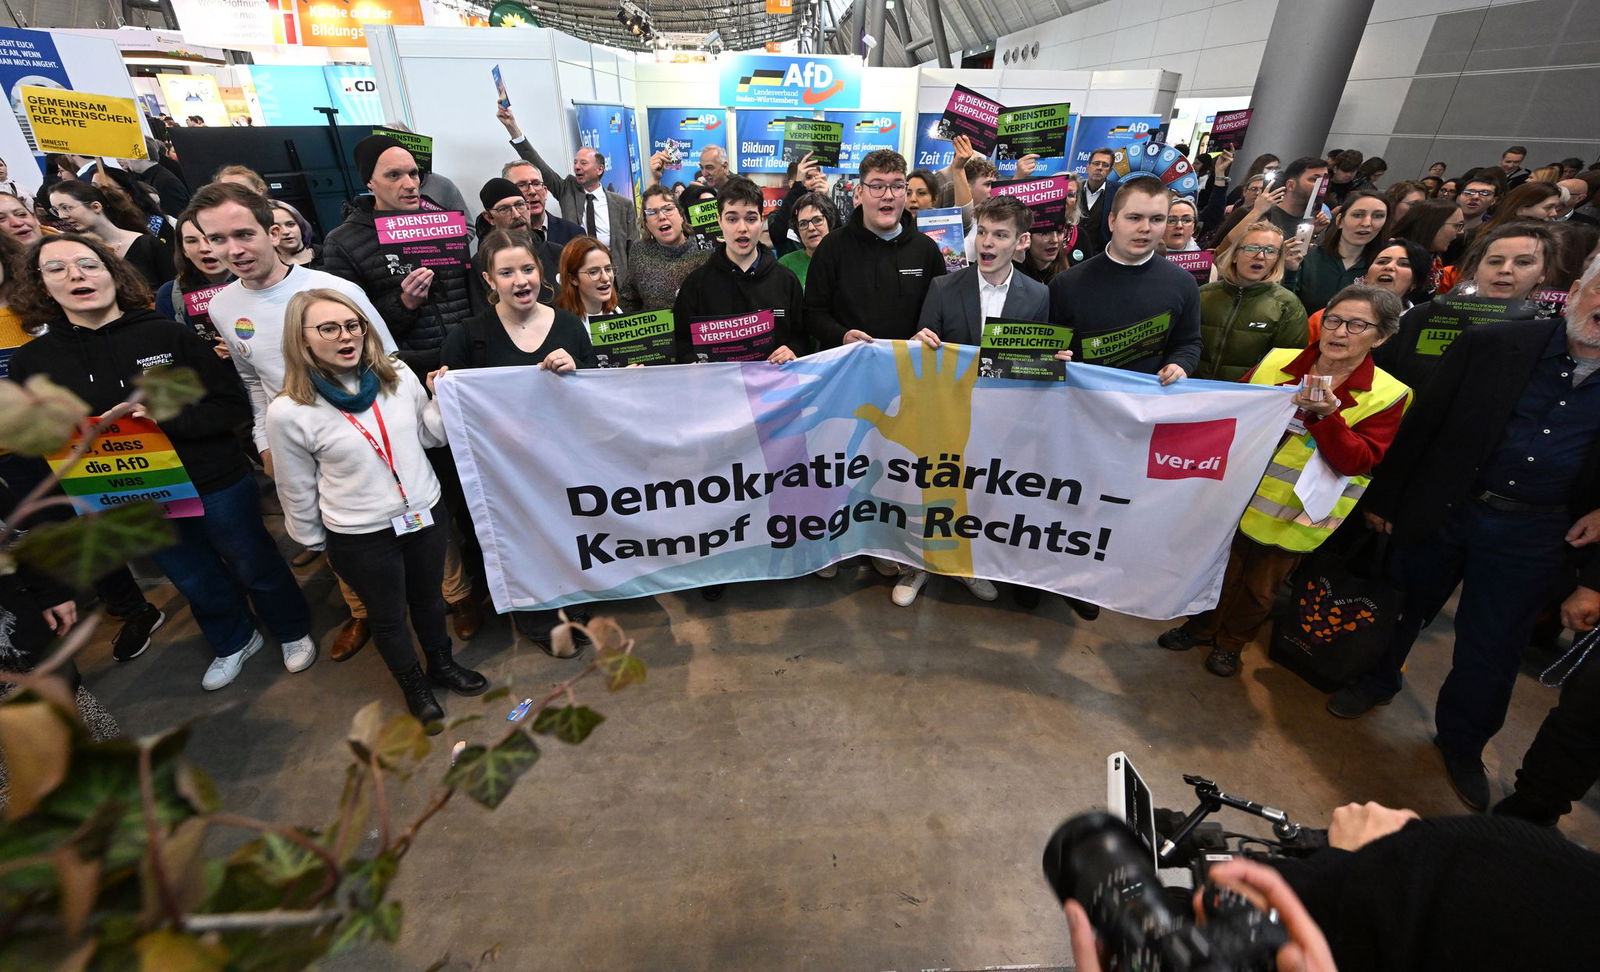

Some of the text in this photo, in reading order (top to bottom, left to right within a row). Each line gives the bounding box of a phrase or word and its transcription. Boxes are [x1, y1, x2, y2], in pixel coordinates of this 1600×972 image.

[18, 40, 34, 49] EUCH
[32, 60, 59, 68] ANGEHT.
[783, 62, 833, 88] AfD
[354, 80, 376, 92] CD
[27, 95, 107, 112] GEMEINSAM
[30, 105, 137, 124] MENSCHEN- FÜR
[698, 114, 717, 125] AfD
[954, 102, 998, 125] VERPFLICHTE
[1004, 108, 1056, 124] #DIENSTEID
[33, 115, 87, 128] RECHTE
[792, 123, 832, 132] #DIENSTEID
[873, 117, 892, 127] AfD
[1004, 117, 1065, 133] VERPFLICHTET!
[1128, 122, 1149, 132] AfD
[41, 138, 68, 147] AMNESTY
[790, 132, 839, 141] VERPFLICHTET!
[742, 141, 776, 156] Bildung
[742, 158, 763, 168] statt
[919, 152, 954, 165] Zeit fü
[998, 180, 1054, 196] #DIENSTEID
[385, 214, 448, 230] #DIENSTEID
[386, 225, 463, 240] VERPFLICHTET!
[599, 314, 657, 333] #DIENSTEID
[699, 315, 758, 333] #DIENSTEID
[992, 325, 1054, 336] #DIENSTEID
[600, 323, 670, 343] VERPFLICHTET!
[700, 322, 770, 341] VERPFLICHTET!
[1091, 321, 1153, 348] #DIENSTEID
[990, 337, 1064, 348] VERPFLICHTET!
[1091, 325, 1164, 356] VERPFLICHTET!
[137, 352, 172, 365] KORREKTUR
[142, 359, 170, 368] KUMPEL
[102, 440, 144, 453] dass
[86, 456, 150, 474] die AfD
[1154, 452, 1220, 471] ver.di
[107, 475, 145, 488] was
[566, 452, 870, 517] Demokratie
[888, 453, 1083, 505] stärken
[576, 500, 1113, 571] Kampf gegen Rechts!
